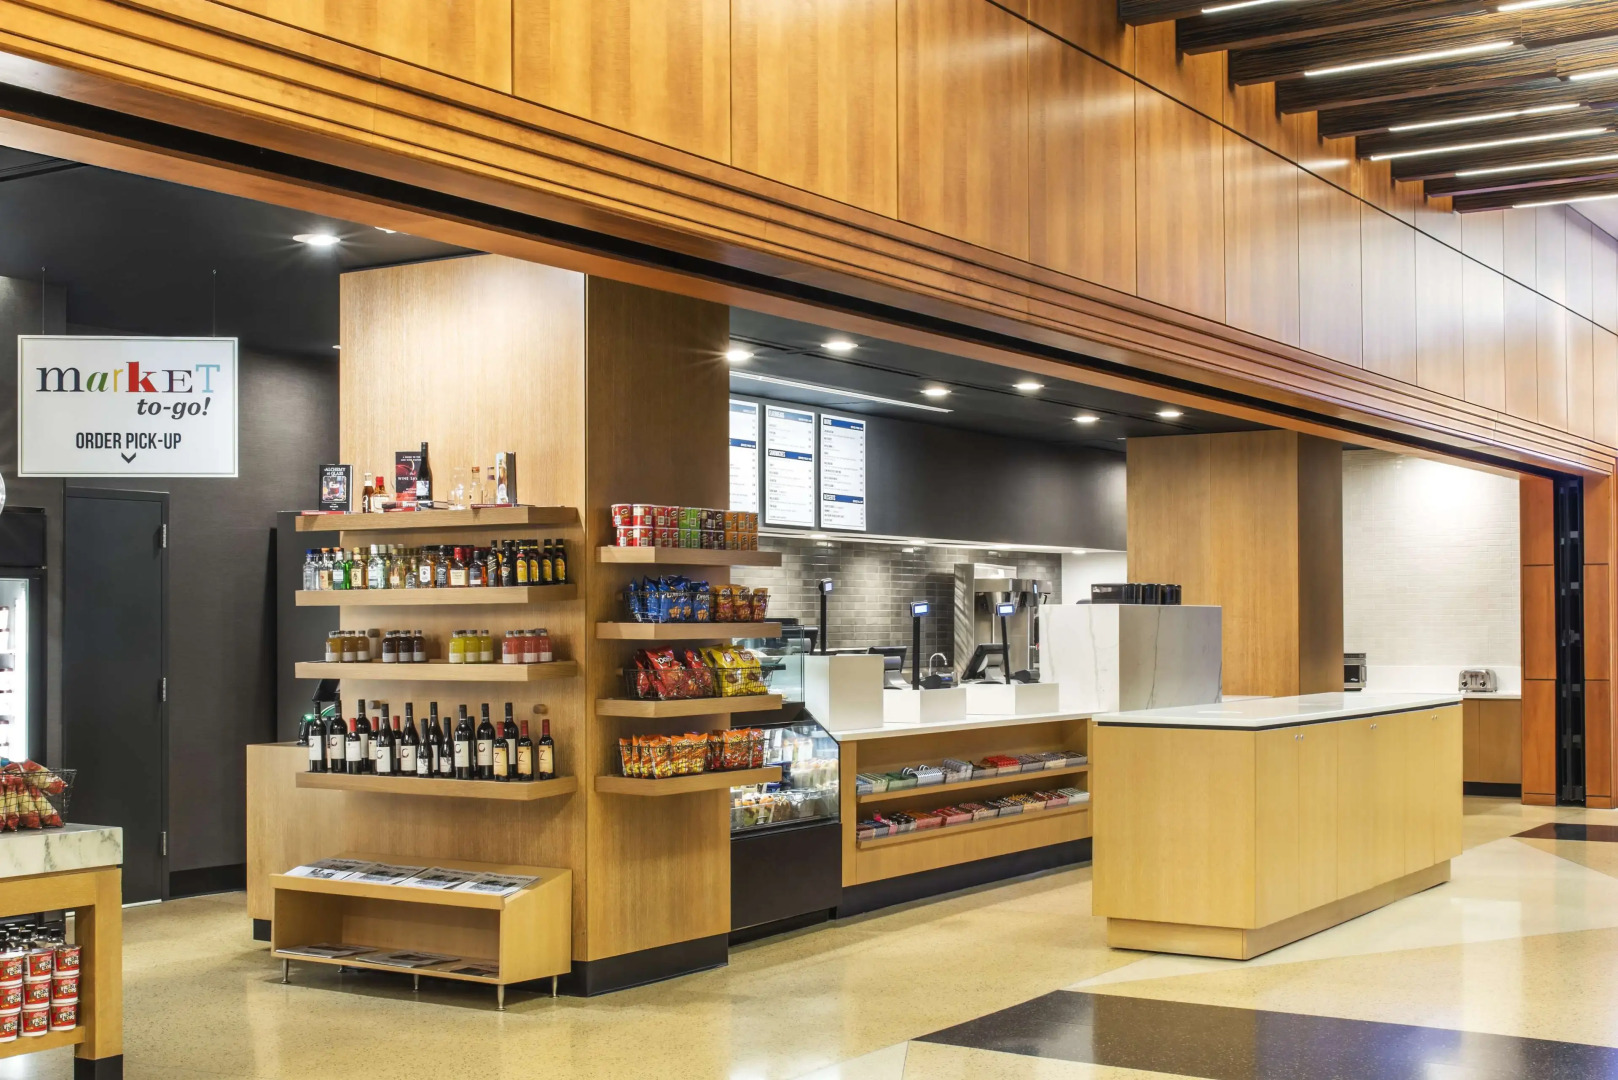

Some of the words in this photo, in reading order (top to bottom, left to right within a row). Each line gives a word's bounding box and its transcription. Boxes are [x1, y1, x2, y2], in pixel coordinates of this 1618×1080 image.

[137, 397, 211, 420] to-go!
[76, 432, 122, 449] ORDER
[126, 433, 182, 450] PICK-UP
